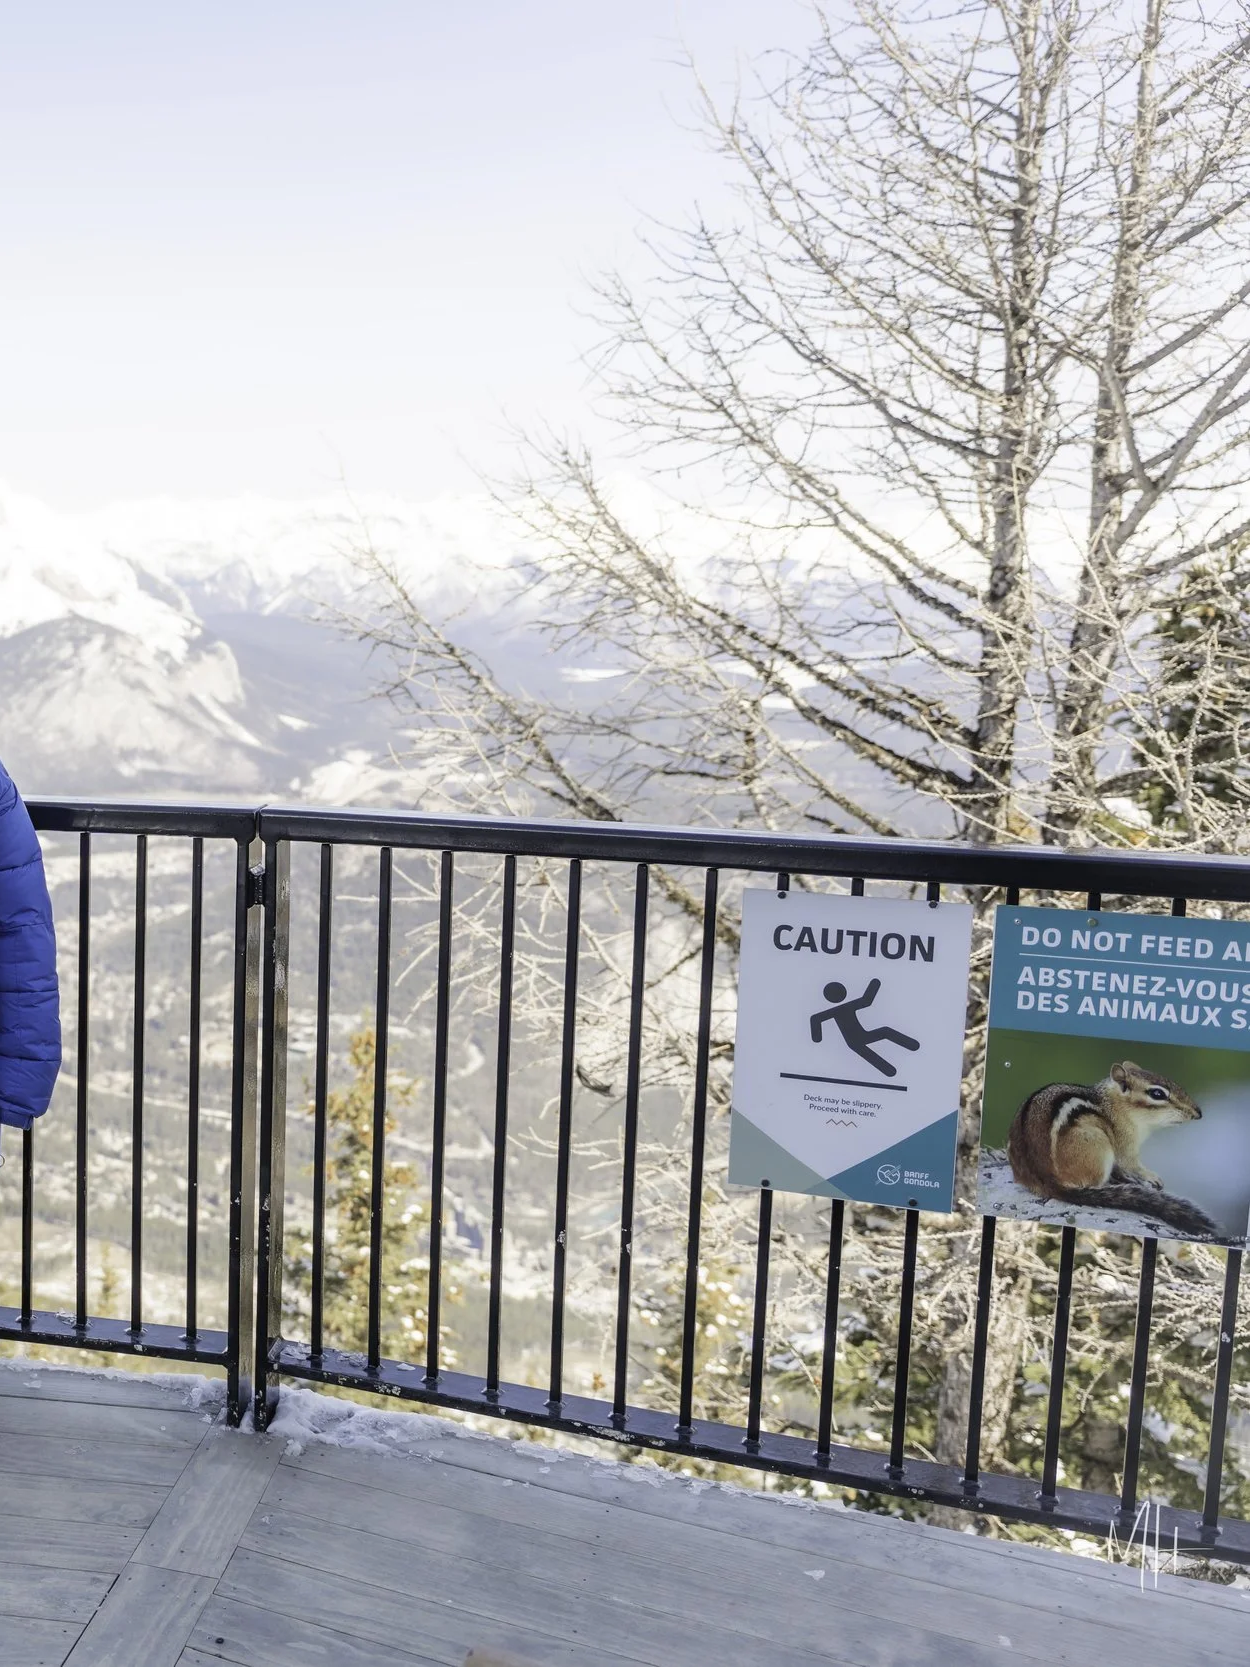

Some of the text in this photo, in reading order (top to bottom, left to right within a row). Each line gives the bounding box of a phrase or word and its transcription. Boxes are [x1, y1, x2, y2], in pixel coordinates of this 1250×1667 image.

[773, 924, 935, 962] CAUTION
[1021, 926, 1250, 962] DO NOT FEED A
[1016, 990, 1250, 1030] DES ANIMAUX S
[803, 1093, 823, 1102] Deck
[824, 1097, 840, 1105] may
[852, 1099, 883, 1110] slippery.
[809, 1103, 877, 1118] Proceed with care.
[903, 1177, 940, 1189] GONDOLA
[904, 1170, 930, 1180] BANFF
